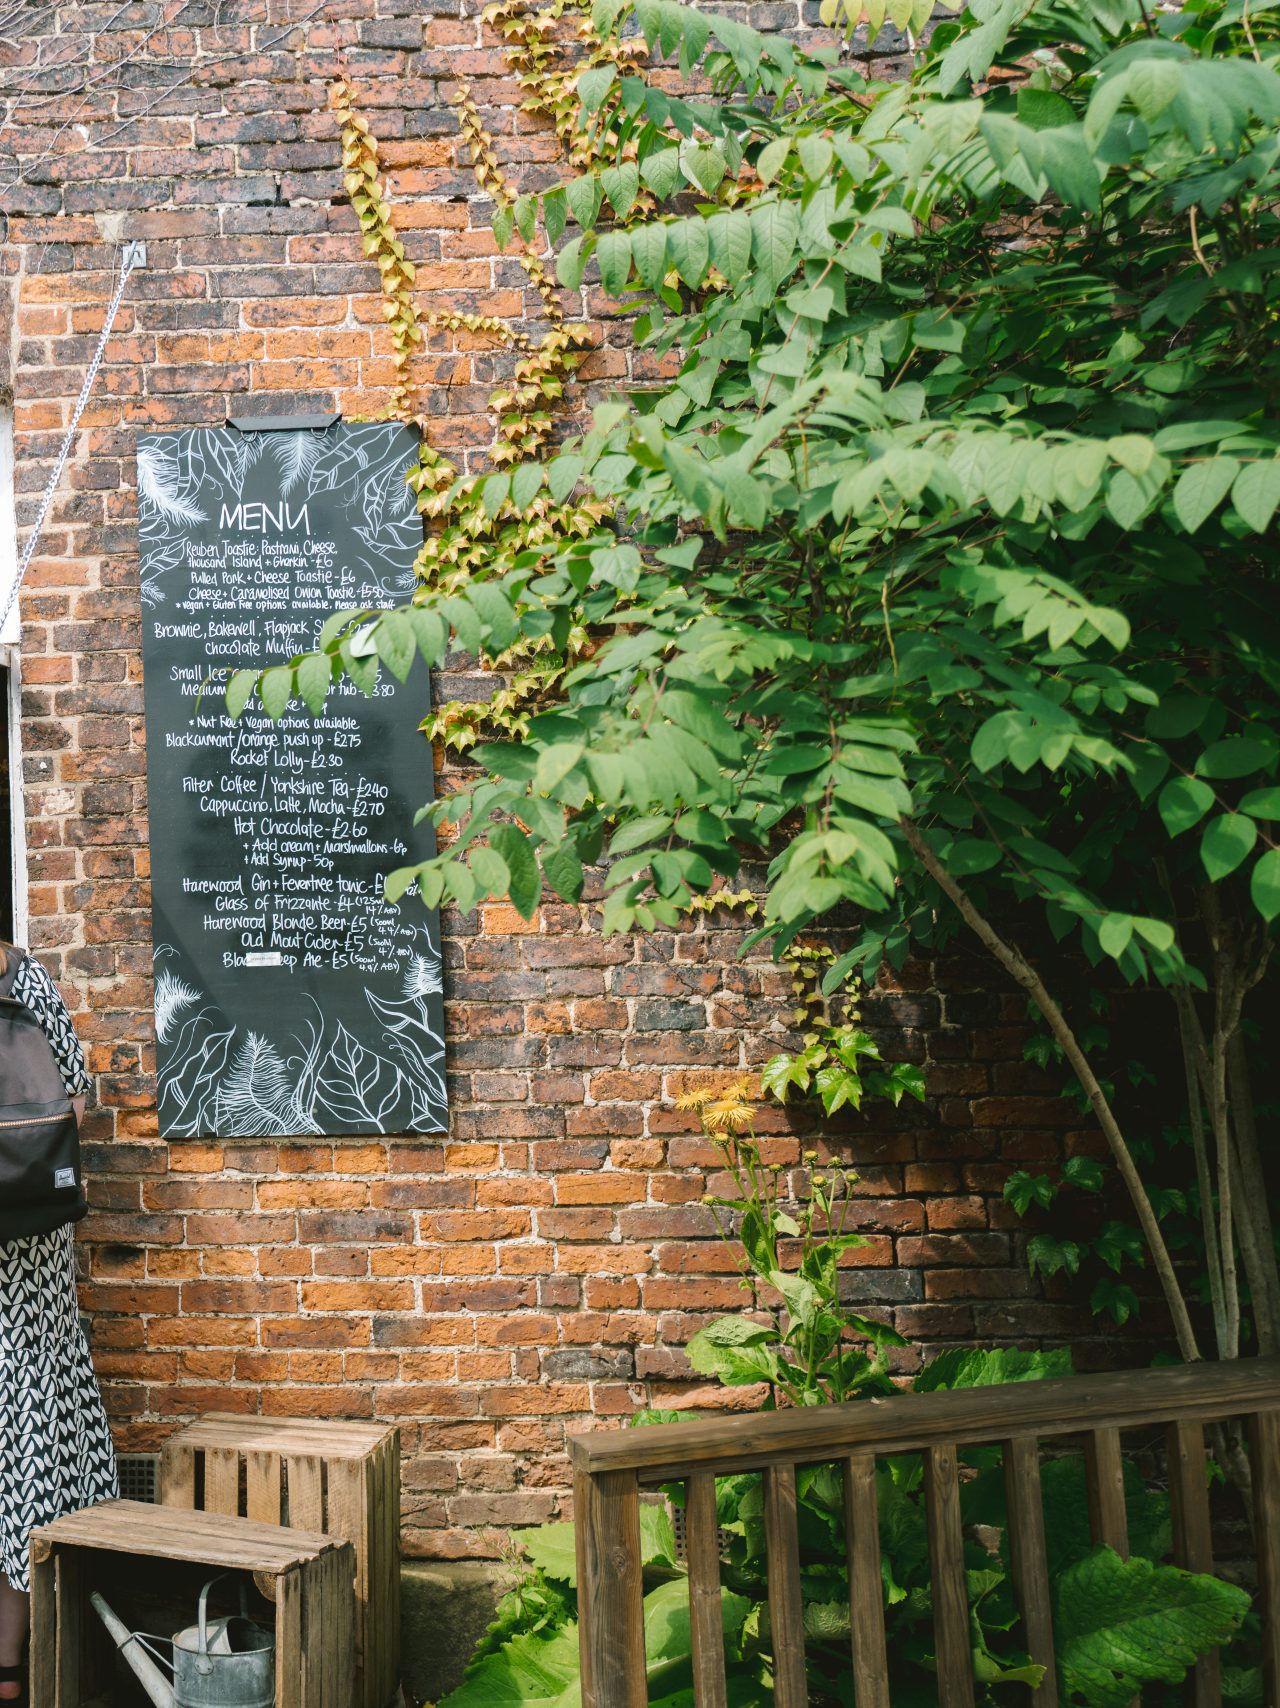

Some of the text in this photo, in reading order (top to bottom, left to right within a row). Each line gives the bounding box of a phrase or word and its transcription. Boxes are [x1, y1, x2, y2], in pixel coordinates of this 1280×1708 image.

[220, 501, 311, 535] MENU
[187, 541, 220, 559] Reuben
[187, 555, 226, 569] thousand
[232, 555, 263, 570] Island
[191, 572, 217, 586] Pulled
[222, 571, 246, 584] Pork
[254, 569, 291, 584] Cheese
[295, 571, 333, 584] Toastie
[189, 587, 222, 602] Cheese
[231, 586, 290, 601] Caramelised
[295, 587, 322, 599] Onion
[326, 585, 356, 599] Toastie
[213, 600, 236, 610] Gluten
[239, 600, 253, 609] Free
[256, 600, 287, 612] options
[335, 600, 358, 610] Please
[359, 600, 373, 609] ask
[376, 599, 395, 611] staff
[264, 621, 309, 639] Flapjack
[266, 636, 304, 658] Muffin
[170, 666, 202, 681] Small
[339, 682, 357, 695] tub
[197, 716, 217, 730] Nut
[277, 716, 309, 731] options
[314, 716, 360, 730] available
[283, 733, 310, 750] push
[312, 735, 323, 751] up
[230, 748, 269, 766] Rocket
[183, 777, 214, 792] Filter
[220, 776, 258, 792] Coffee
[270, 775, 326, 795] Yorkshire
[308, 798, 345, 815] Mocha
[234, 817, 256, 836] Hot
[261, 817, 324, 839] Chocolate
[252, 838, 278, 852] Add
[281, 841, 314, 853] cream
[250, 853, 269, 866] Add
[272, 854, 307, 872] Syrup
[183, 878, 243, 896] Harewood
[251, 873, 271, 891] Gin
[281, 874, 334, 892] Fevertree
[215, 896, 249, 911] Glass
[254, 894, 270, 911] of
[274, 896, 332, 912] Frizzante
[203, 915, 266, 932] Harewood
[272, 914, 318, 930] Blonde
[241, 932, 264, 948] Old
[271, 931, 304, 949] Mout
[303, 954, 322, 968] Ale
